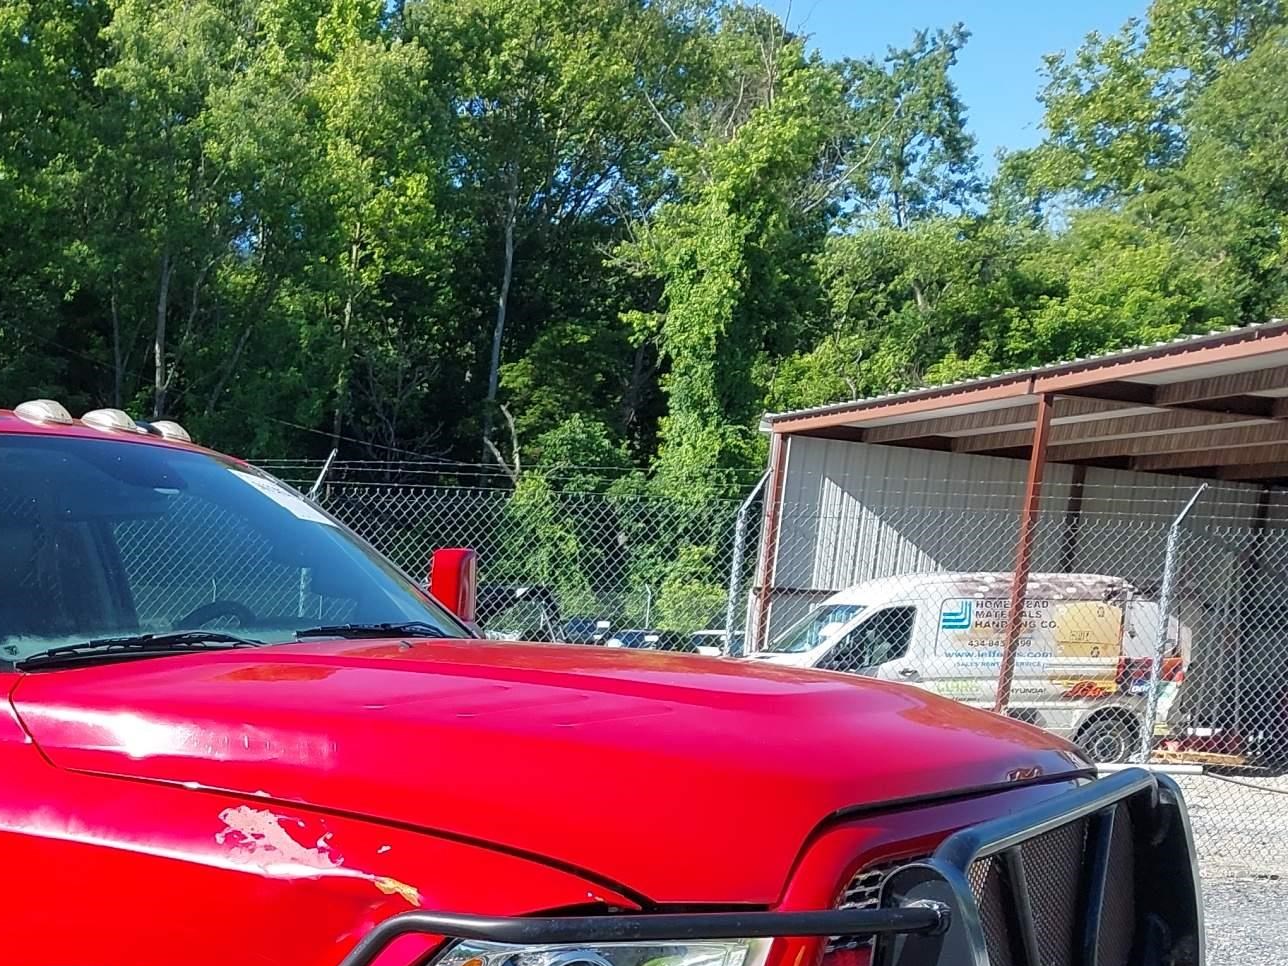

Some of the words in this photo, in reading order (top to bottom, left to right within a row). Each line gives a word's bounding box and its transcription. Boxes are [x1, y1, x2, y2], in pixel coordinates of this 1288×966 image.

[975, 600, 1049, 609] HOMEEAD
[975, 610, 1042, 618] MATEALS
[974, 620, 1037, 629] HANDNG
[1040, 620, 1060, 629] CO.
